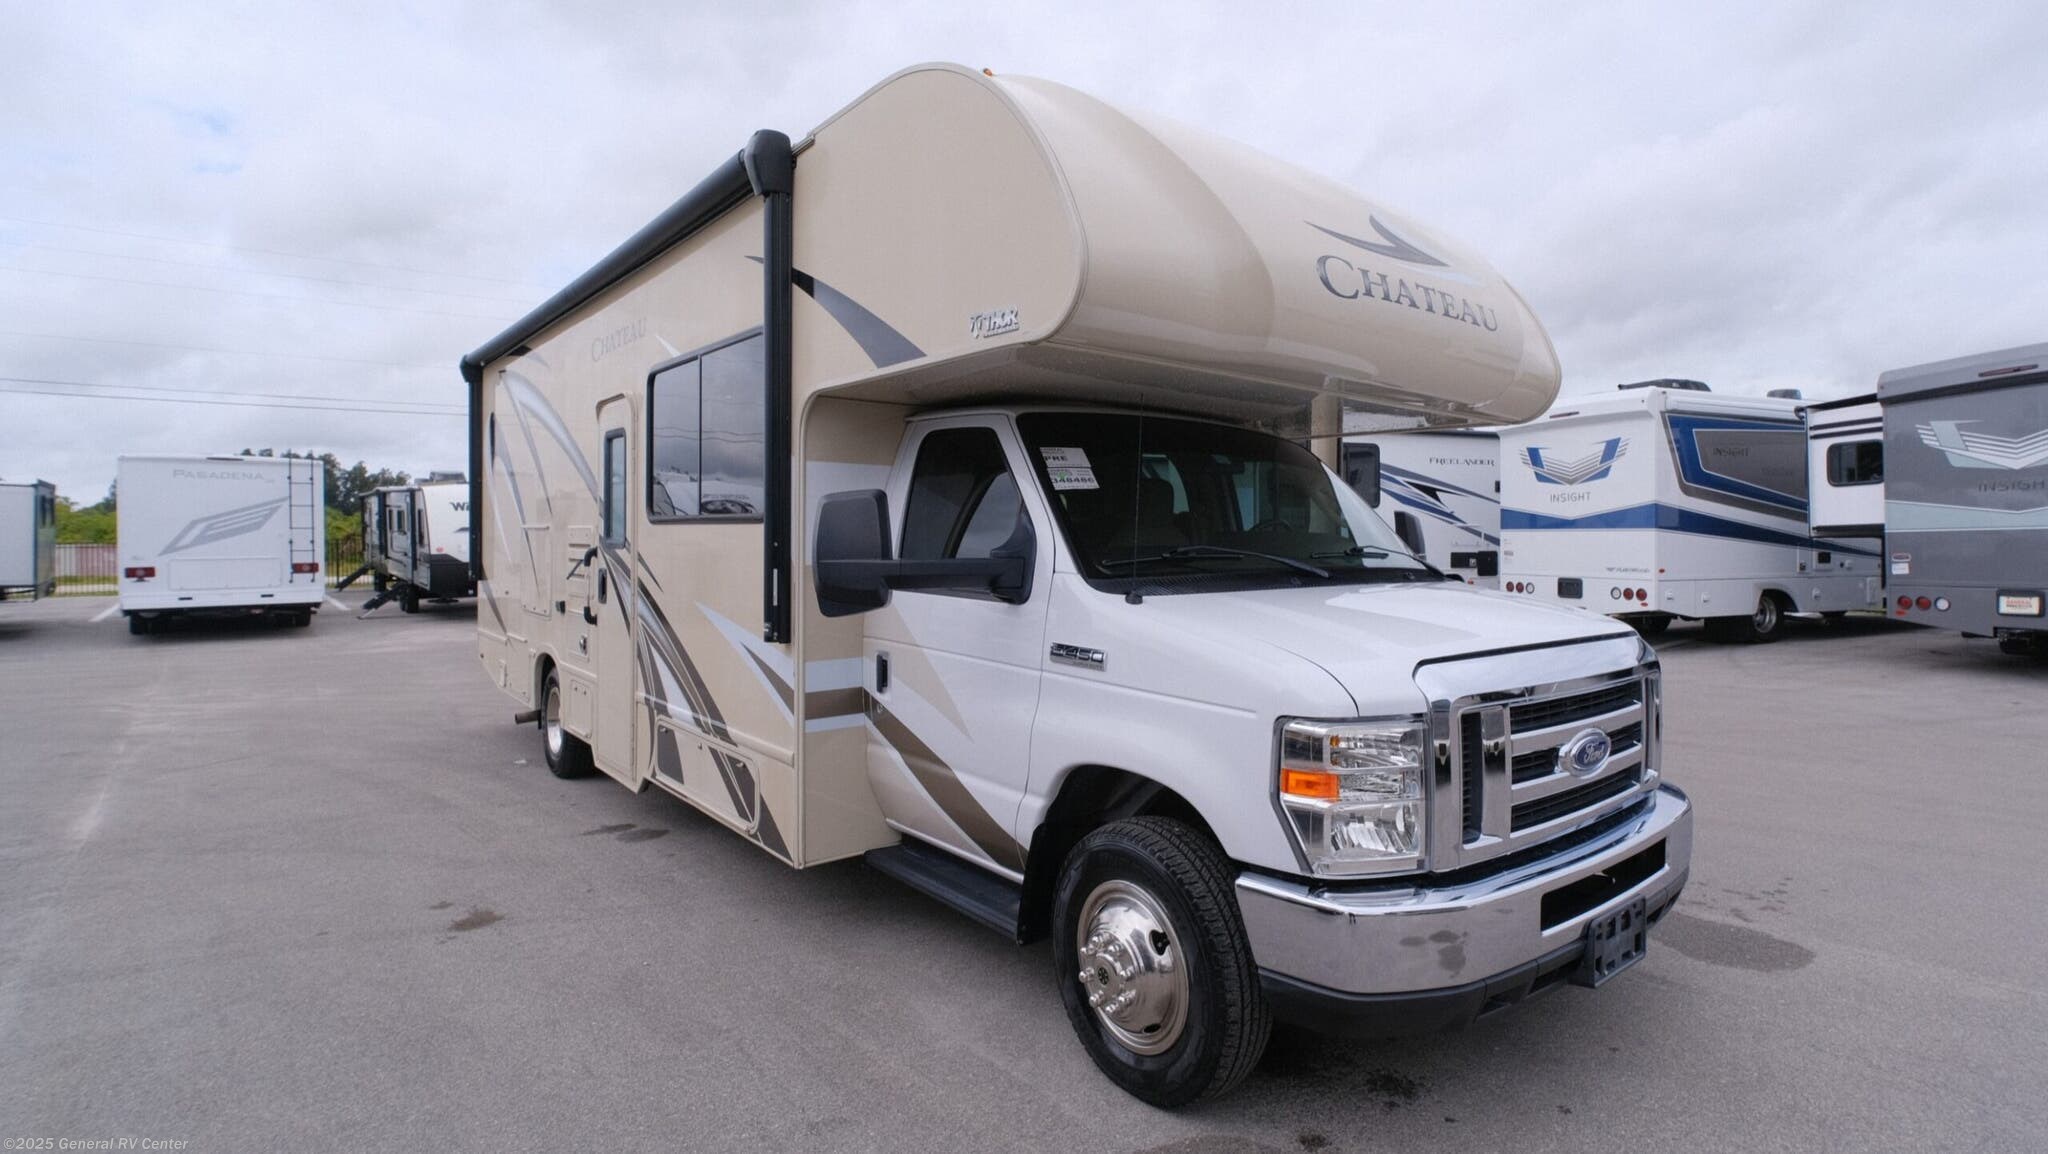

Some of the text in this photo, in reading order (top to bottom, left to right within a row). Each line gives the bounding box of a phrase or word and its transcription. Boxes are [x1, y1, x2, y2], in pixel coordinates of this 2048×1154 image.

[1316, 254, 1498, 332] CHATEAU
[591, 316, 647, 362] CHATEAU
[1428, 457, 1496, 467] FREELANDER
[172, 468, 265, 481] PASADENA
[1978, 479, 2046, 492] INSIGH
[1550, 491, 1592, 504] INSIGHT
